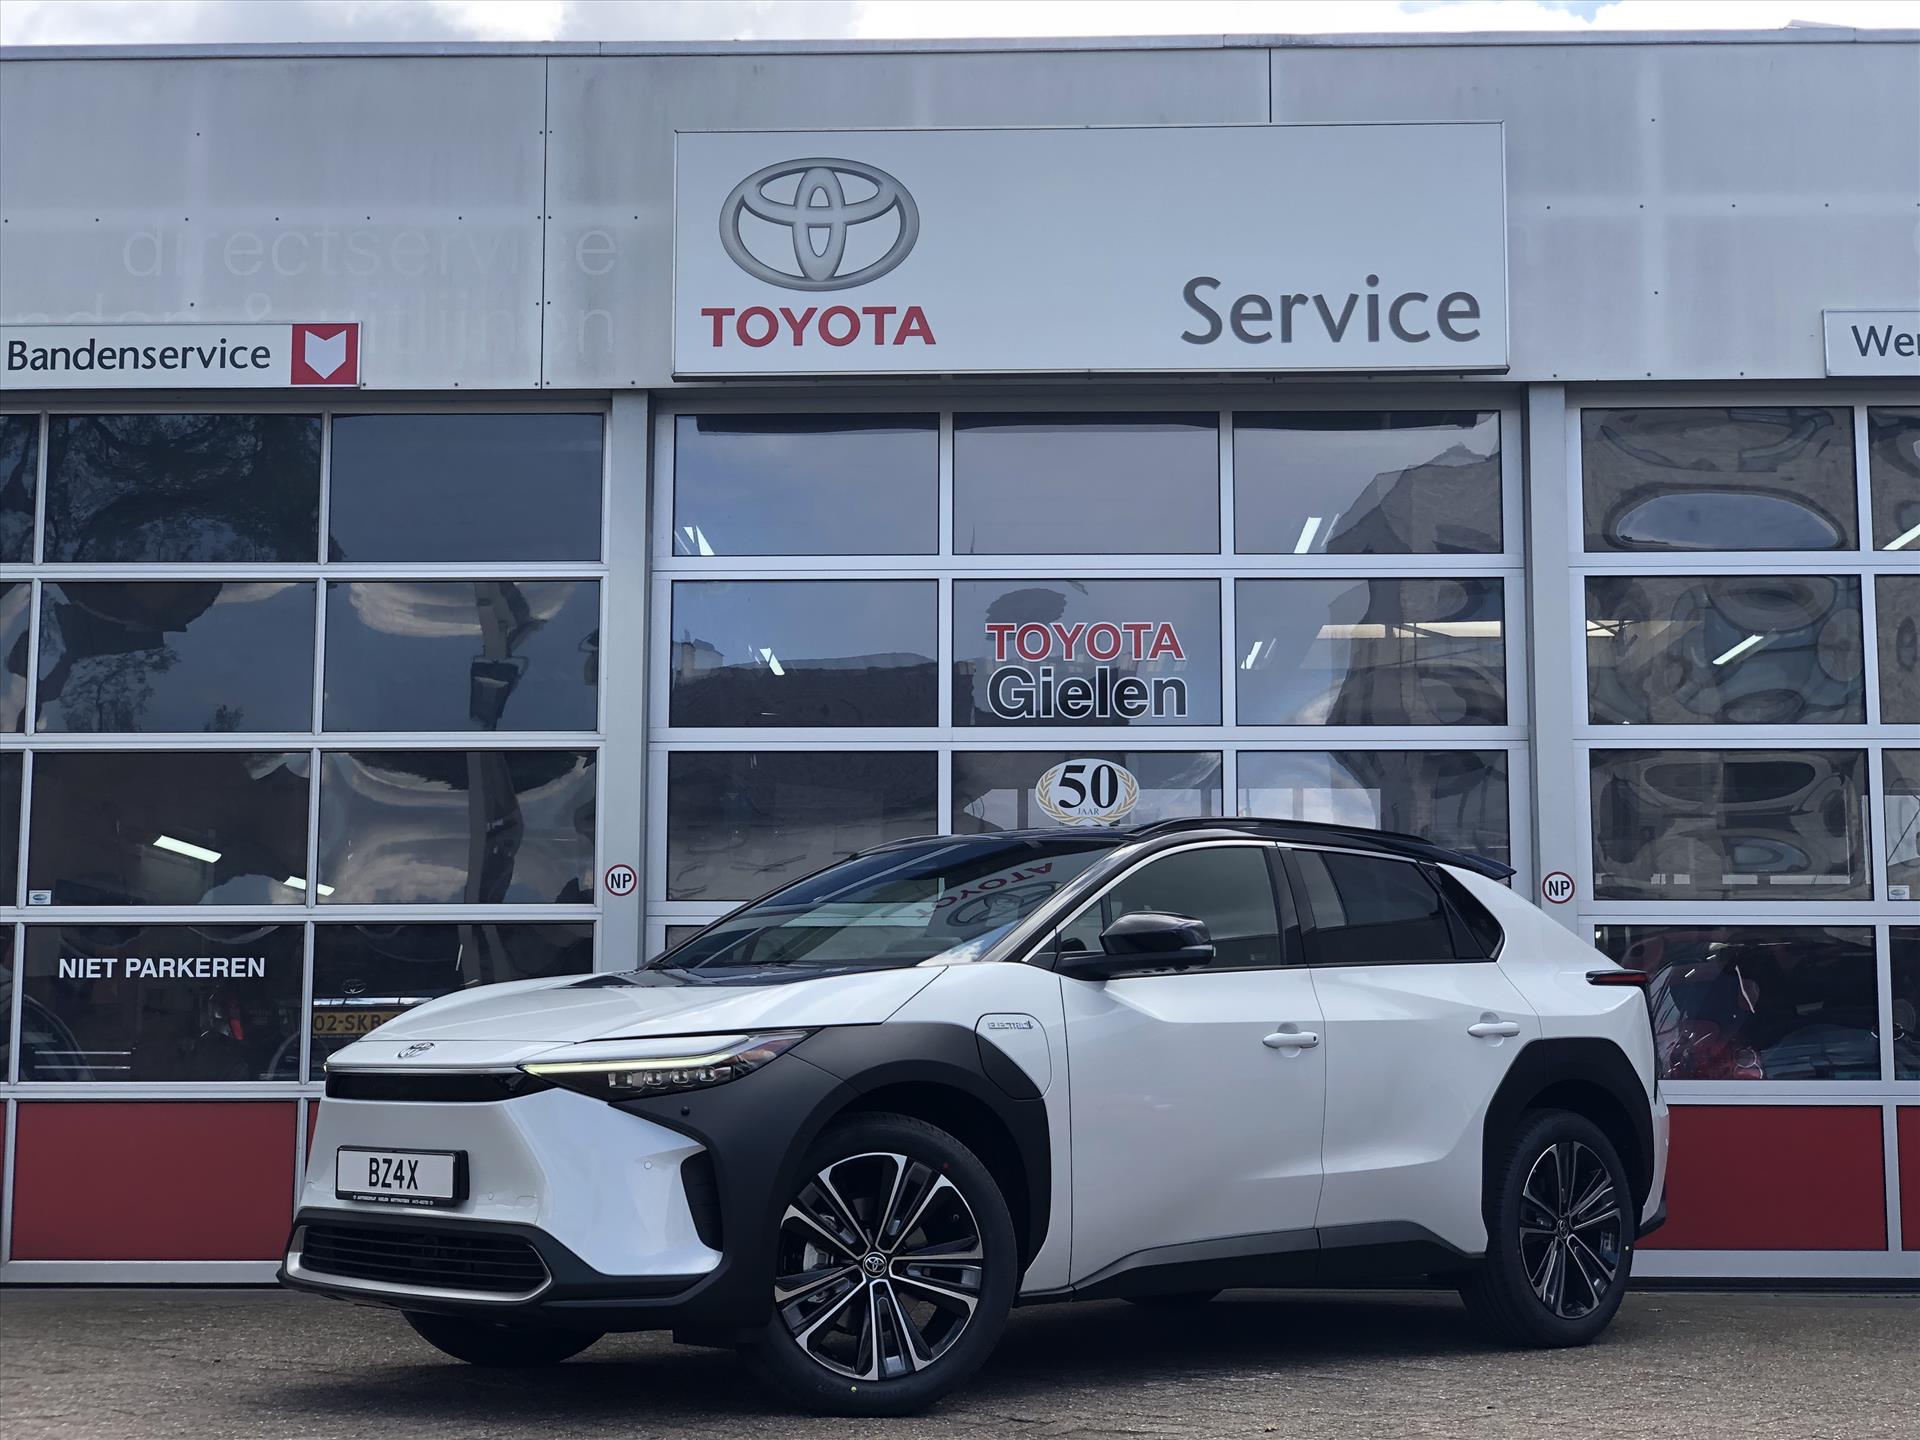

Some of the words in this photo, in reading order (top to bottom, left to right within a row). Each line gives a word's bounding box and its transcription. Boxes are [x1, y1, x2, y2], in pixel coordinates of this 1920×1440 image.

[1181, 274, 1482, 345] Service
[701, 306, 937, 347] TOYOTA
[7, 339, 271, 371] Bandenservice
[985, 622, 1186, 662] TOYOTA
[986, 665, 1188, 720] Gielen
[1058, 764, 1119, 809] 50
[1077, 807, 1100, 816] JAAR
[610, 873, 632, 889] NP
[1548, 880, 1571, 897] NP
[58, 958, 118, 978] NIET
[125, 957, 266, 978] PARKEREN
[368, 1157, 419, 1190] BZ4X
